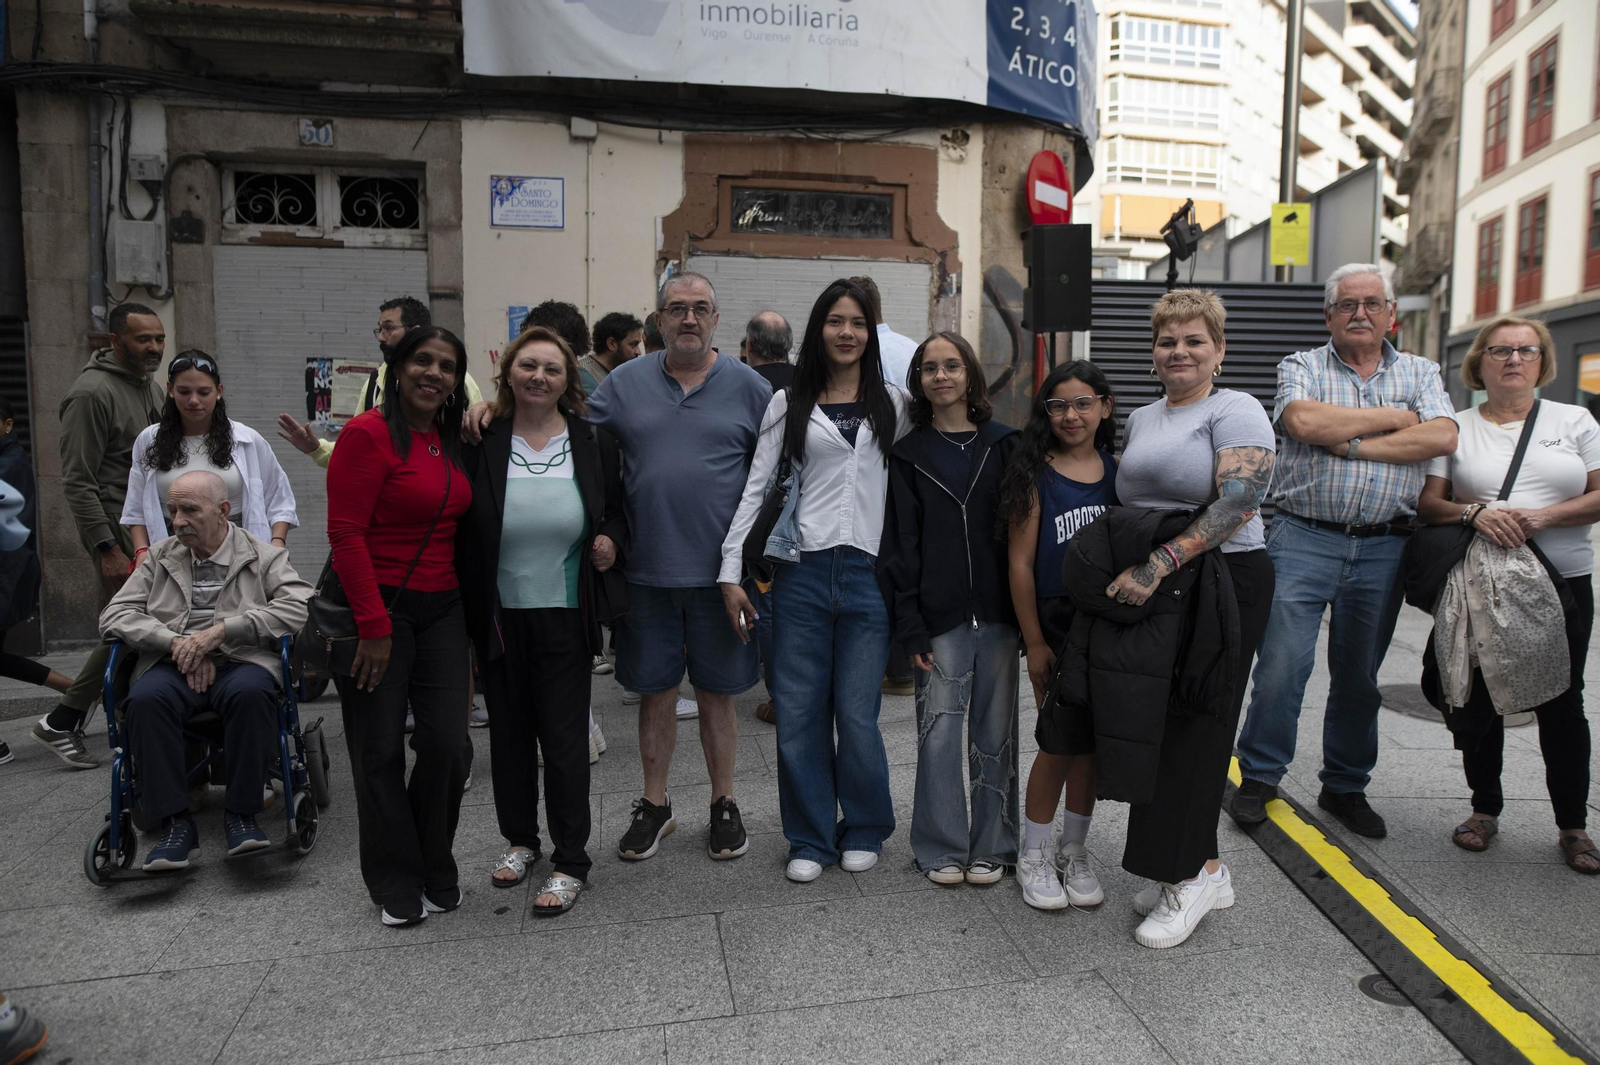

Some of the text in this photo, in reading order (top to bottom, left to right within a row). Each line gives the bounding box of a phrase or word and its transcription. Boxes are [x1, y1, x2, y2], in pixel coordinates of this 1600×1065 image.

[700, 0, 859, 31] inmobiliaria
[1010, 6, 1031, 36] 2,
[1039, 15, 1056, 45] 3,
[701, 27, 727, 40] Vigo
[743, 29, 791, 42] Ourense
[818, 34, 859, 47] Coruña
[1008, 45, 1076, 87] ÁTICO
[520, 186, 552, 198] SANTO
